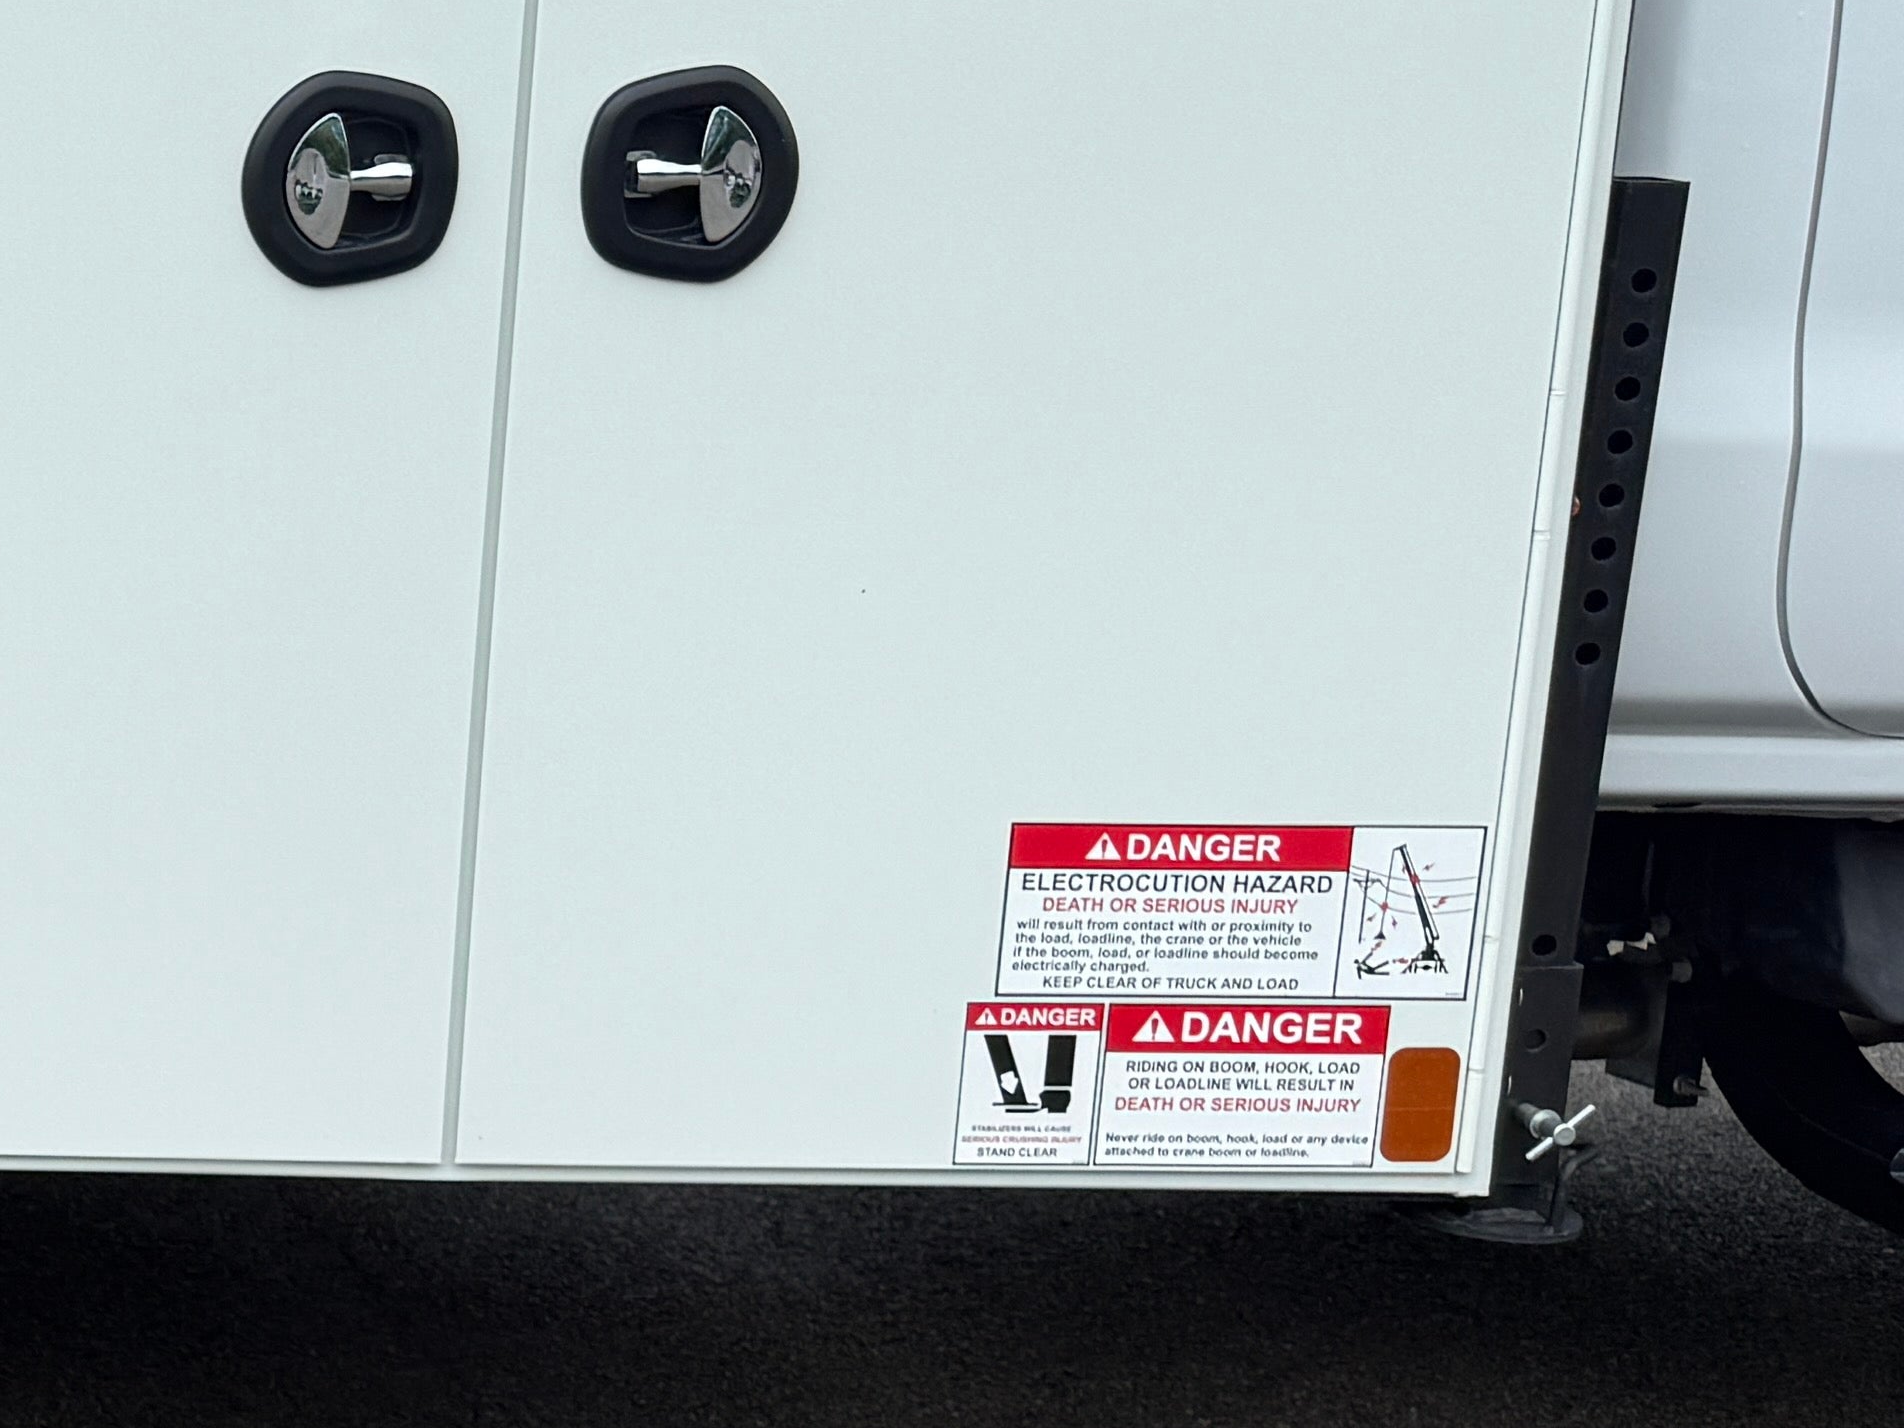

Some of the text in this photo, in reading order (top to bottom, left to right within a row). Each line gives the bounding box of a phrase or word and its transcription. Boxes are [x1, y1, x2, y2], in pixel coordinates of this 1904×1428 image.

[1126, 833, 1281, 862] DANGER
[1022, 873, 1333, 893] ELECTROCUTION HAZARD
[1043, 897, 1298, 914] DEATH OR SERIOUS INJURY
[1017, 918, 1312, 934] will result from contact with or proximity to
[1016, 932, 1302, 946] the load, loadline, the crane or the vehicle
[1013, 946, 1318, 960] if the boom, load, or loadline should become
[1012, 960, 1150, 974] electrically charged.
[1042, 976, 1299, 990] KEEP CLEAR OF TRUCK AND LOAD
[1000, 1008, 1096, 1026] DANGER
[1181, 1011, 1362, 1044] DANGER
[1126, 1060, 1360, 1075] RIDING ON BOOM, HOOK, LOAD
[1128, 1078, 1354, 1092] OR LOADLINE WILL RESULT IN
[1115, 1097, 1361, 1112] DEATH OR SERIOUS INJURY
[1106, 1132, 1139, 1142] Never
[1143, 1132, 1164, 1143] ride
[1168, 1134, 1183, 1143] on
[1186, 1134, 1222, 1144] boom,
[1262, 1134, 1287, 1144] load
[1292, 1136, 1302, 1144] or
[1306, 1136, 1327, 1146] any
[1331, 1134, 1368, 1144] device
[977, 1147, 1057, 1157] STAND CLEAR
[1105, 1146, 1154, 1156] attached
[1158, 1148, 1168, 1156] to
[1172, 1148, 1205, 1156] crane
[1209, 1147, 1241, 1157] boom
[1246, 1149, 1256, 1157] or
